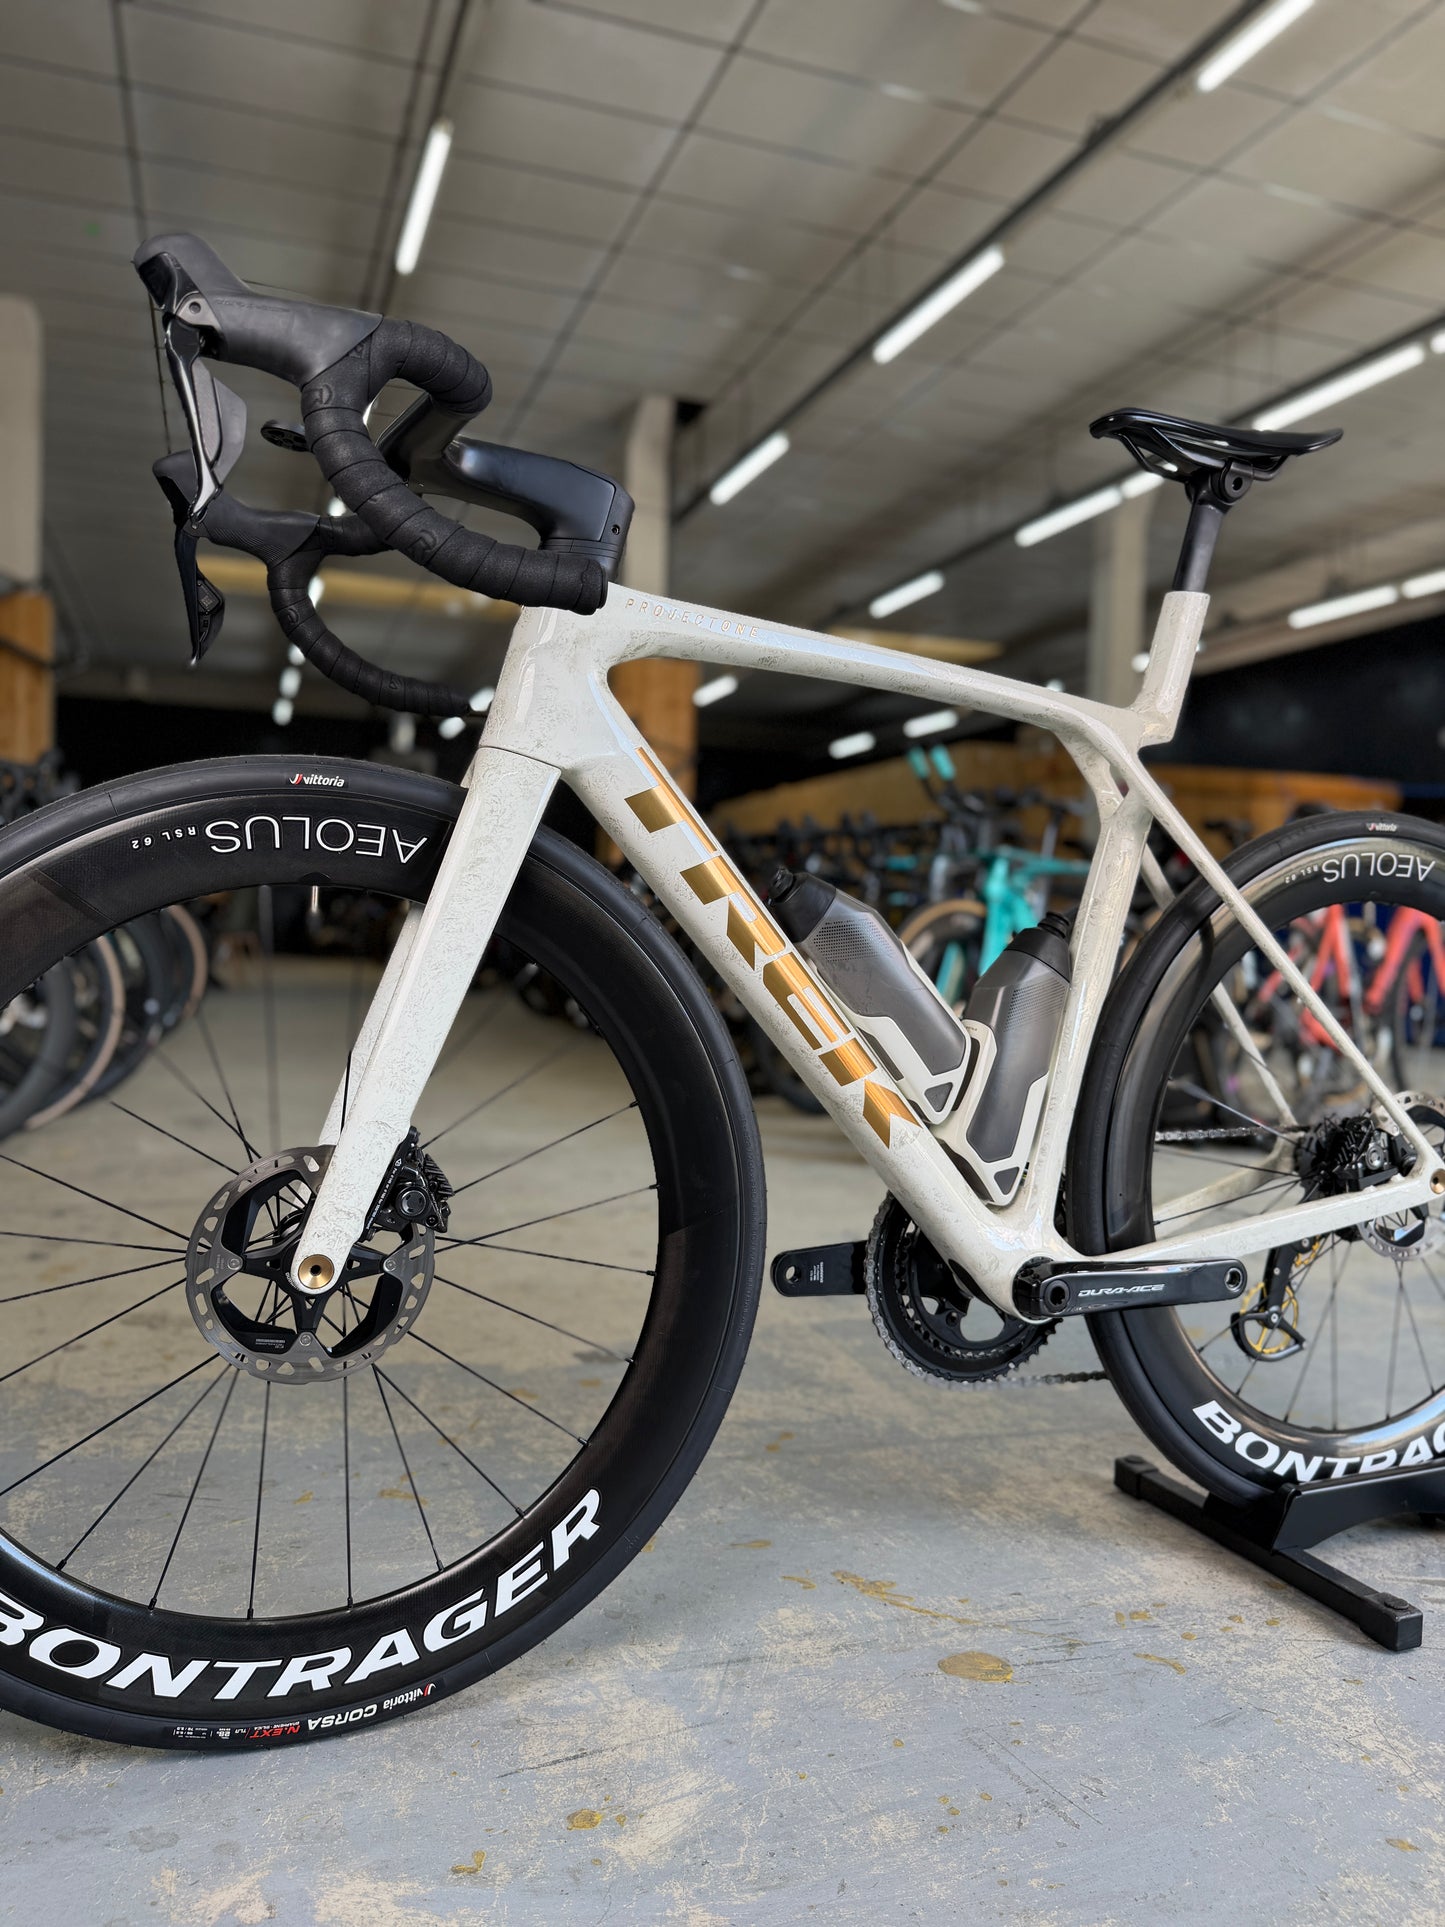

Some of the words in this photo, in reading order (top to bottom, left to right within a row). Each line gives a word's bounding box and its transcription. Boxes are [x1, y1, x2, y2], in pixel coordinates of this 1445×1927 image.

[303, 773, 345, 788] vittoria
[131, 837, 152, 849] 62
[161, 826, 197, 841] RSL
[205, 815, 428, 864] AEOLUS
[1321, 851, 1437, 883] AEOLUS
[624, 746, 923, 1149] TREK
[1077, 1283, 1166, 1297] DURA-ACE
[0, 1489, 601, 1700] BONTRAGER
[383, 1687, 424, 1710] vittoria
[307, 1703, 378, 1731] CORSA
